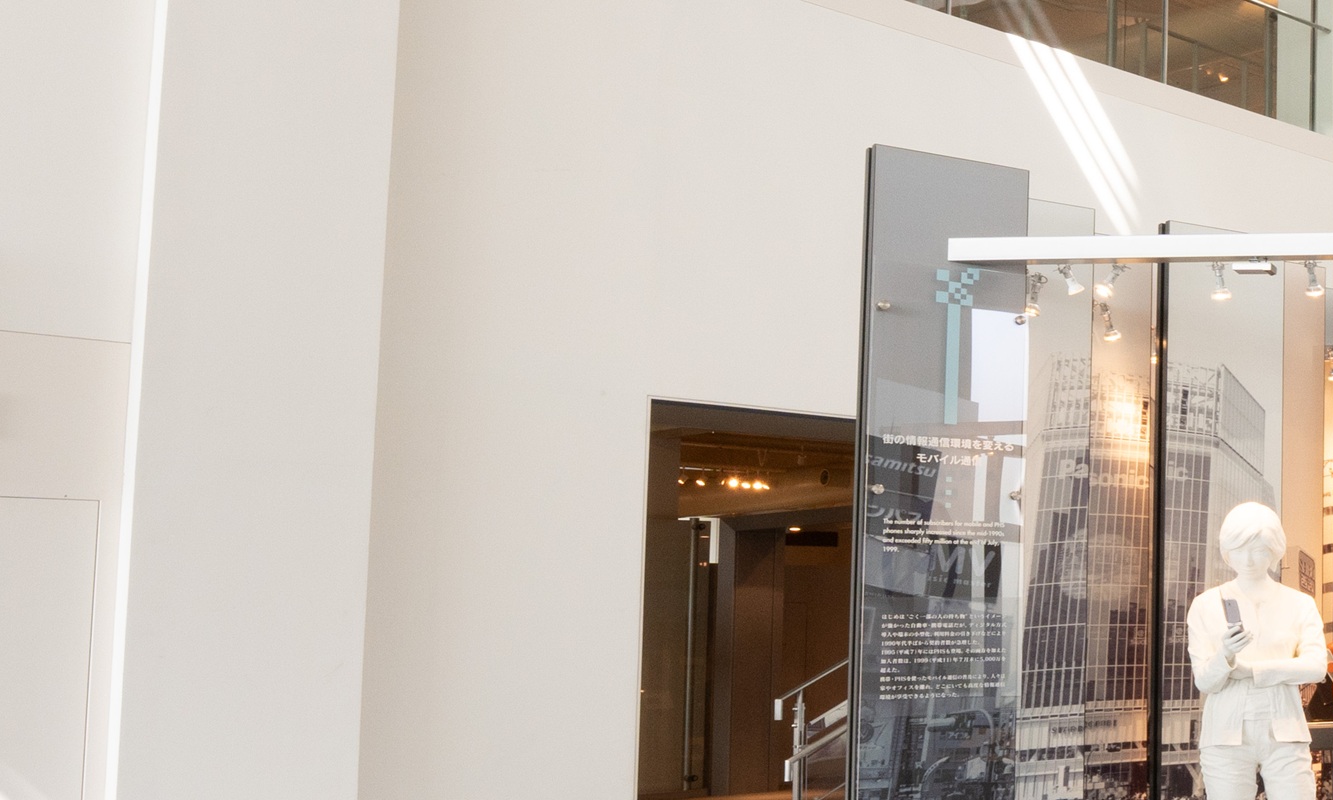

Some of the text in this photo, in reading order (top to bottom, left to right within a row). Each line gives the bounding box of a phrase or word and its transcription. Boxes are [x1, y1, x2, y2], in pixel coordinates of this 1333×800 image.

[882, 434, 1014, 452] 街の情報通信環境を変える
[916, 453, 981, 467] モバイル通信
[882, 528, 903, 536] phones
[904, 528, 925, 537] sharply
[922, 537, 933, 545] fifty
